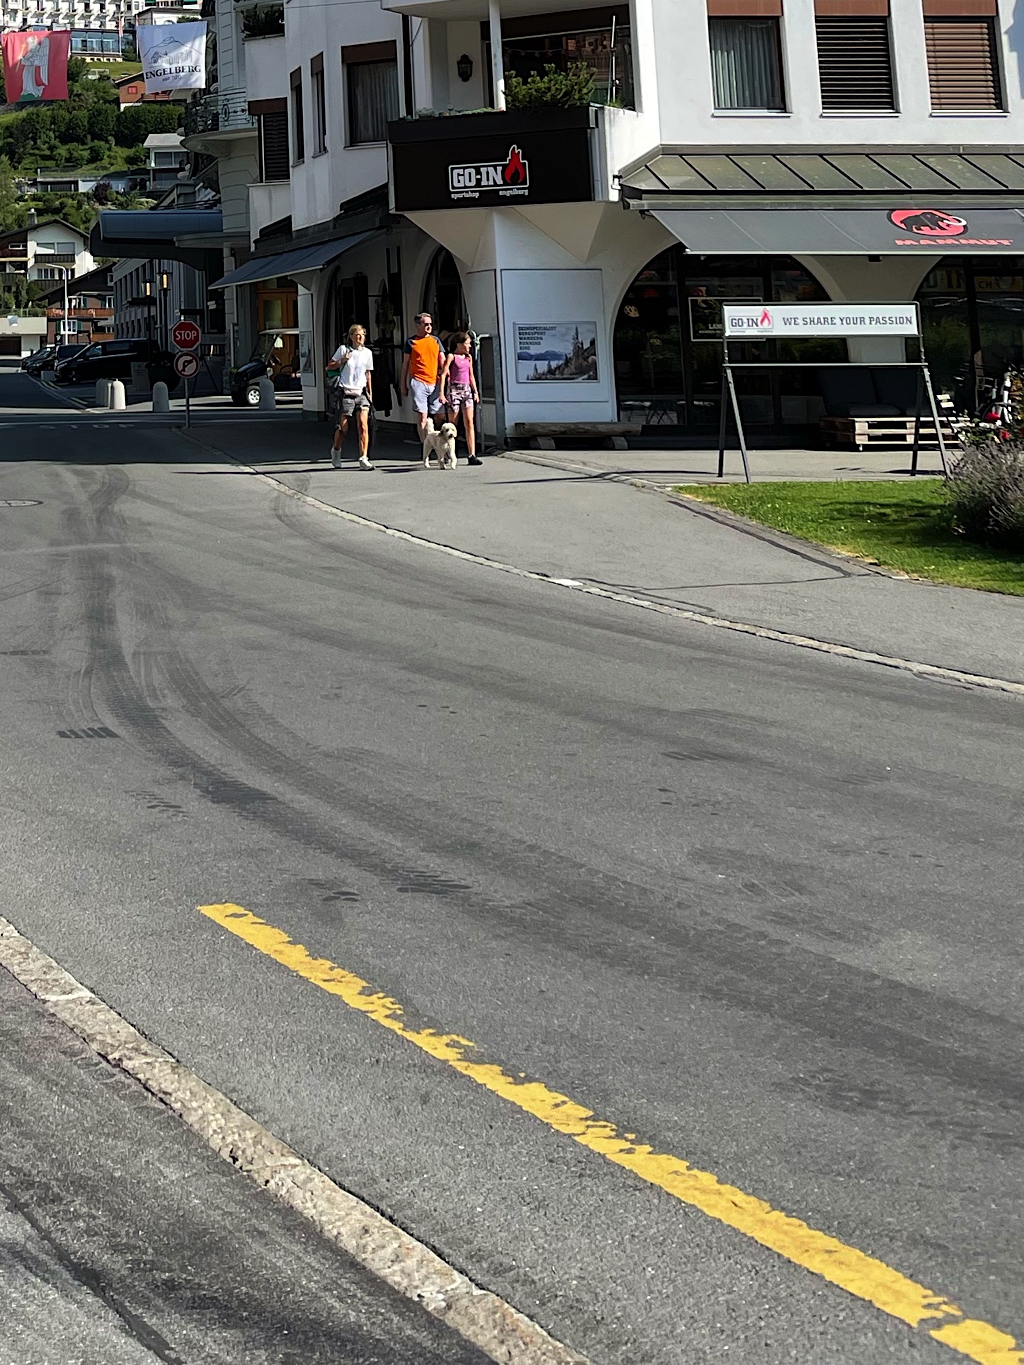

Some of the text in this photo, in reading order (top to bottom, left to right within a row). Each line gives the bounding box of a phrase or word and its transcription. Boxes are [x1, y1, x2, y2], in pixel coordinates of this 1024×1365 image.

[145, 65, 201, 80] ENGELBERG
[452, 166, 504, 187] GO-IN
[499, 188, 528, 196] engelberg
[895, 238, 1012, 246] MAMMUT
[730, 317, 759, 328] GO-IN
[783, 316, 913, 326] WE SHARE YOUR PASSION
[175, 330, 197, 341] STOP
